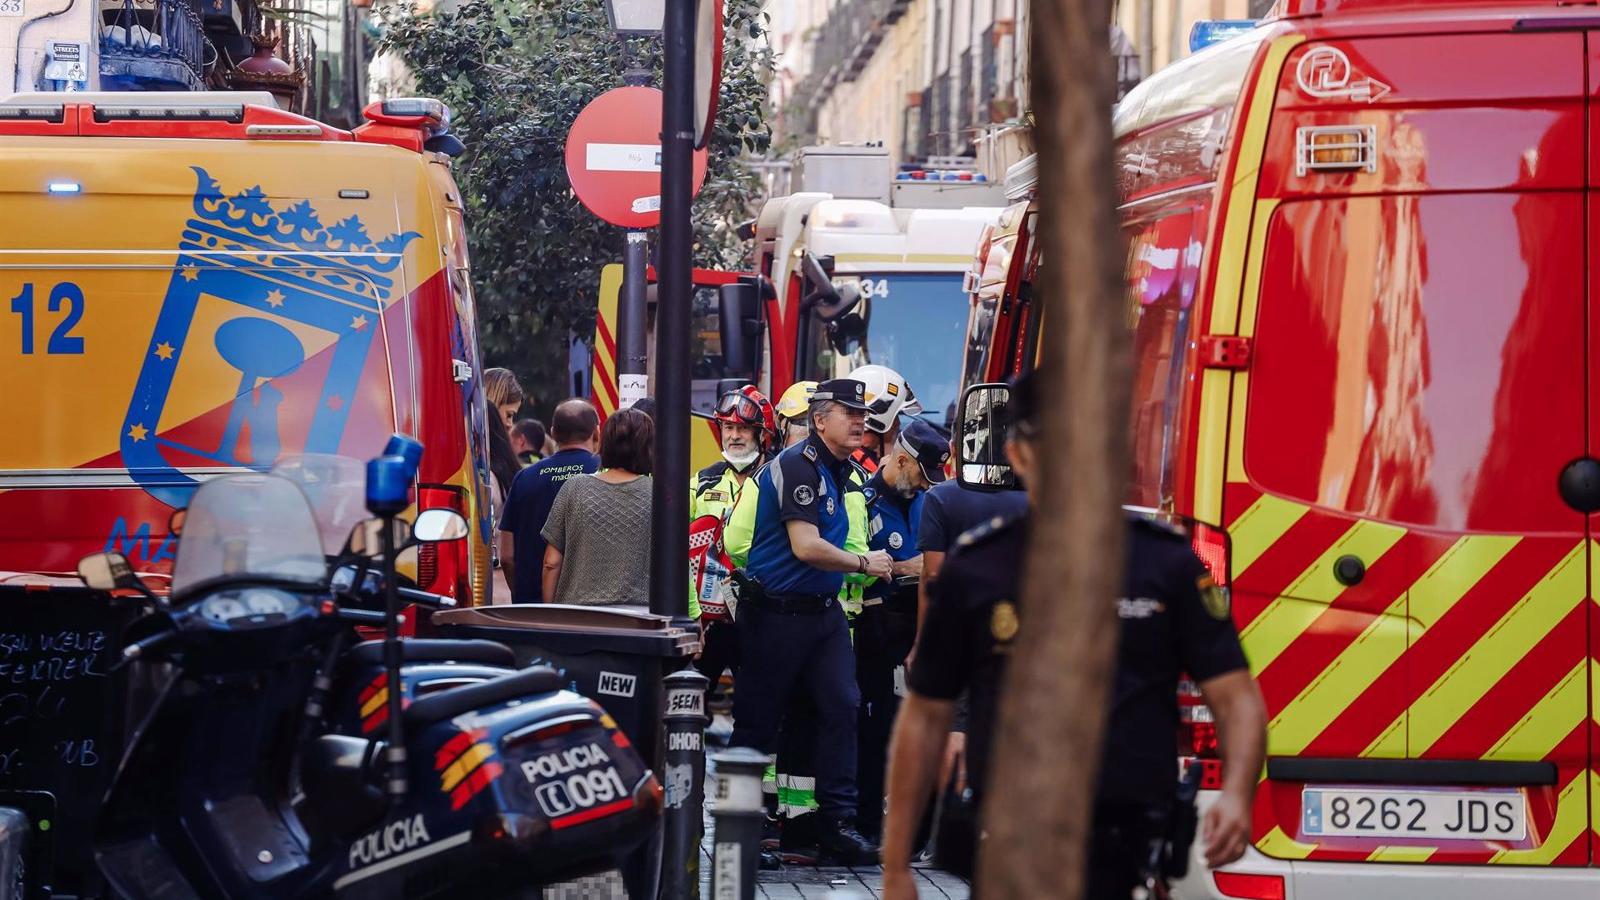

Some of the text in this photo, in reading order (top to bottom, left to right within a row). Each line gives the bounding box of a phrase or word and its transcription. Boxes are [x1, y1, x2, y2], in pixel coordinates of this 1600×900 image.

[11, 281, 85, 354] 12
[540, 464, 584, 476] BOMBEROS
[601, 675, 634, 694] NEW
[669, 731, 701, 751] DHOR
[521, 743, 610, 783] POLICIA
[566, 766, 629, 807] 091
[1330, 797, 1427, 832] 8262
[1444, 799, 1515, 834] JDS
[349, 813, 430, 869] POLICIA
